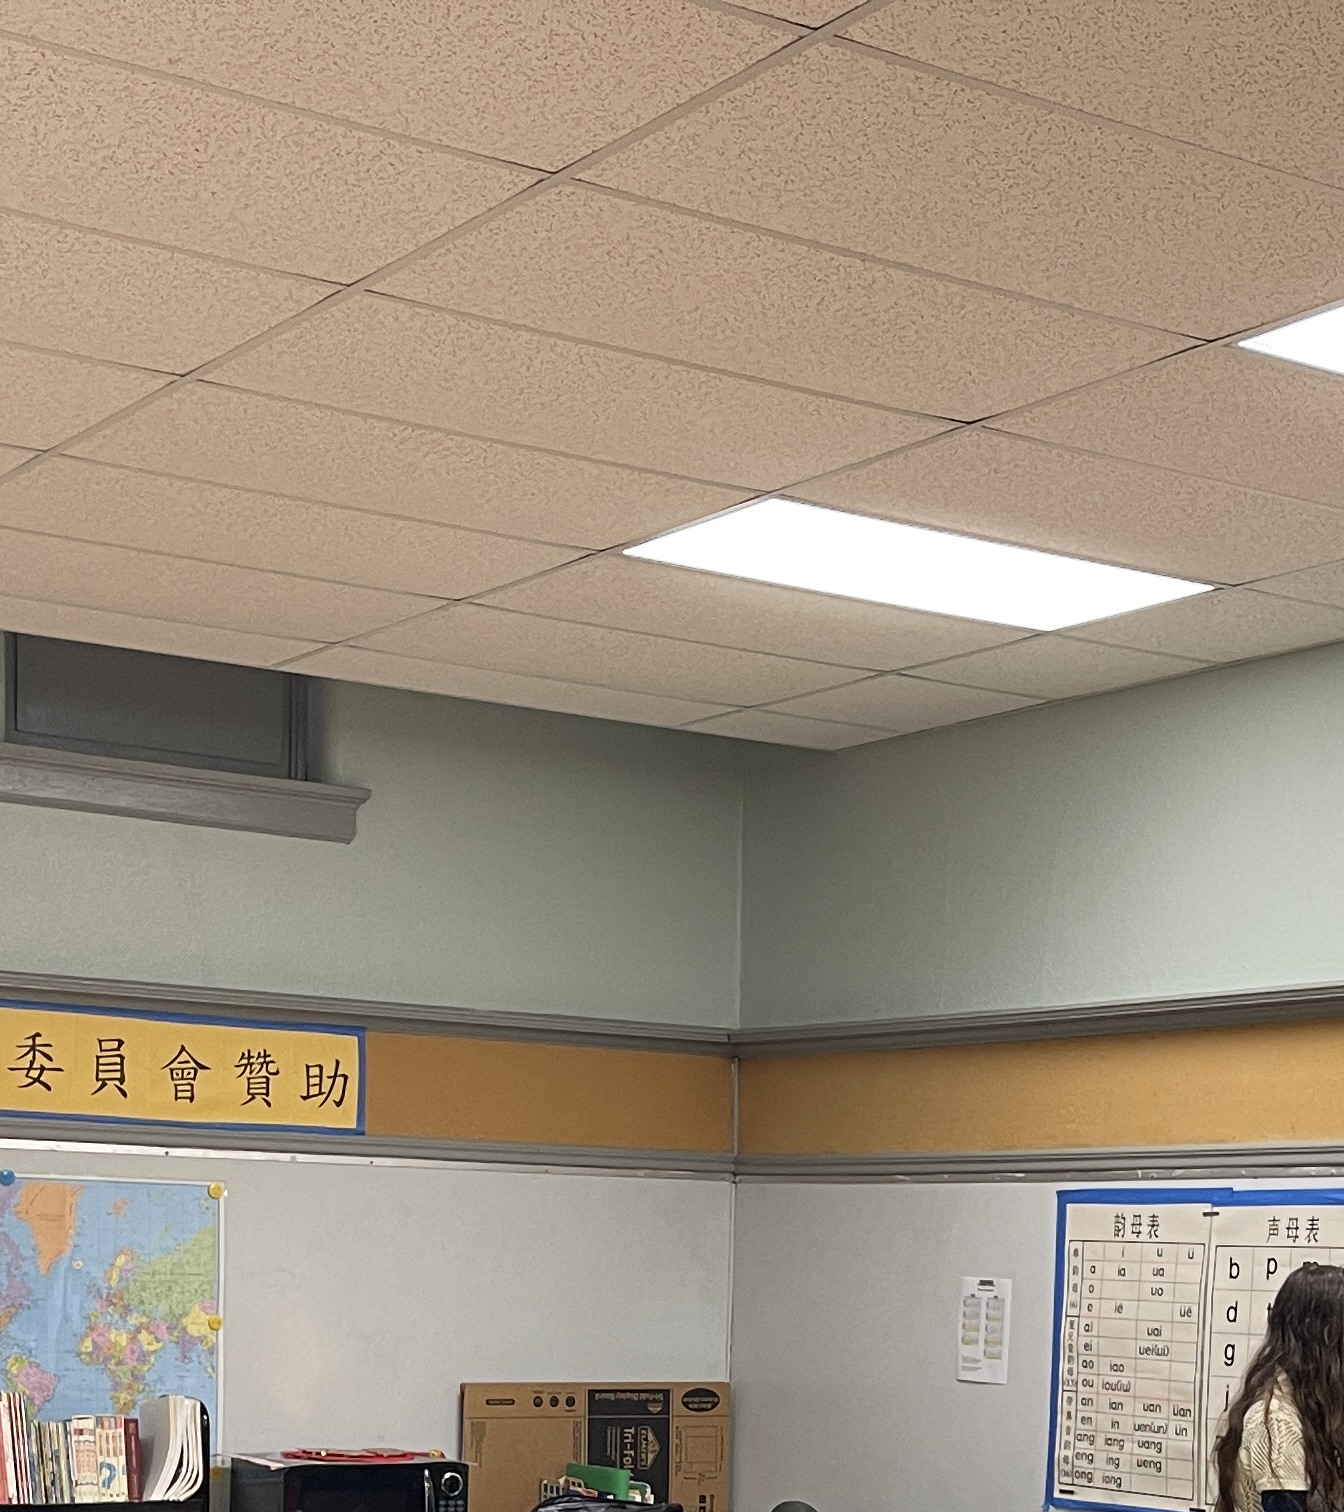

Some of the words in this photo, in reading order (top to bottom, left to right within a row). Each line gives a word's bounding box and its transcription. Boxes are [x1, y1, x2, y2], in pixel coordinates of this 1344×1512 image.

[1113, 1212, 1160, 1239] 韵母表
[1266, 1215, 1320, 1243] 声母表
[1229, 1257, 1240, 1279] b
[1266, 1257, 1278, 1280] p
[1226, 1301, 1238, 1322] d
[1147, 1325, 1163, 1338] uai
[1224, 1344, 1235, 1366] g
[1080, 1396, 1094, 1407] an
[1142, 1401, 1162, 1413] uan
[622, 1426, 636, 1477] Tri-Fol
[1076, 1433, 1095, 1446] ang
[1137, 1439, 1163, 1453] uang
[1075, 1452, 1094, 1465] eng
[1106, 1454, 1120, 1469] ing
[1074, 1470, 1094, 1484] ong
